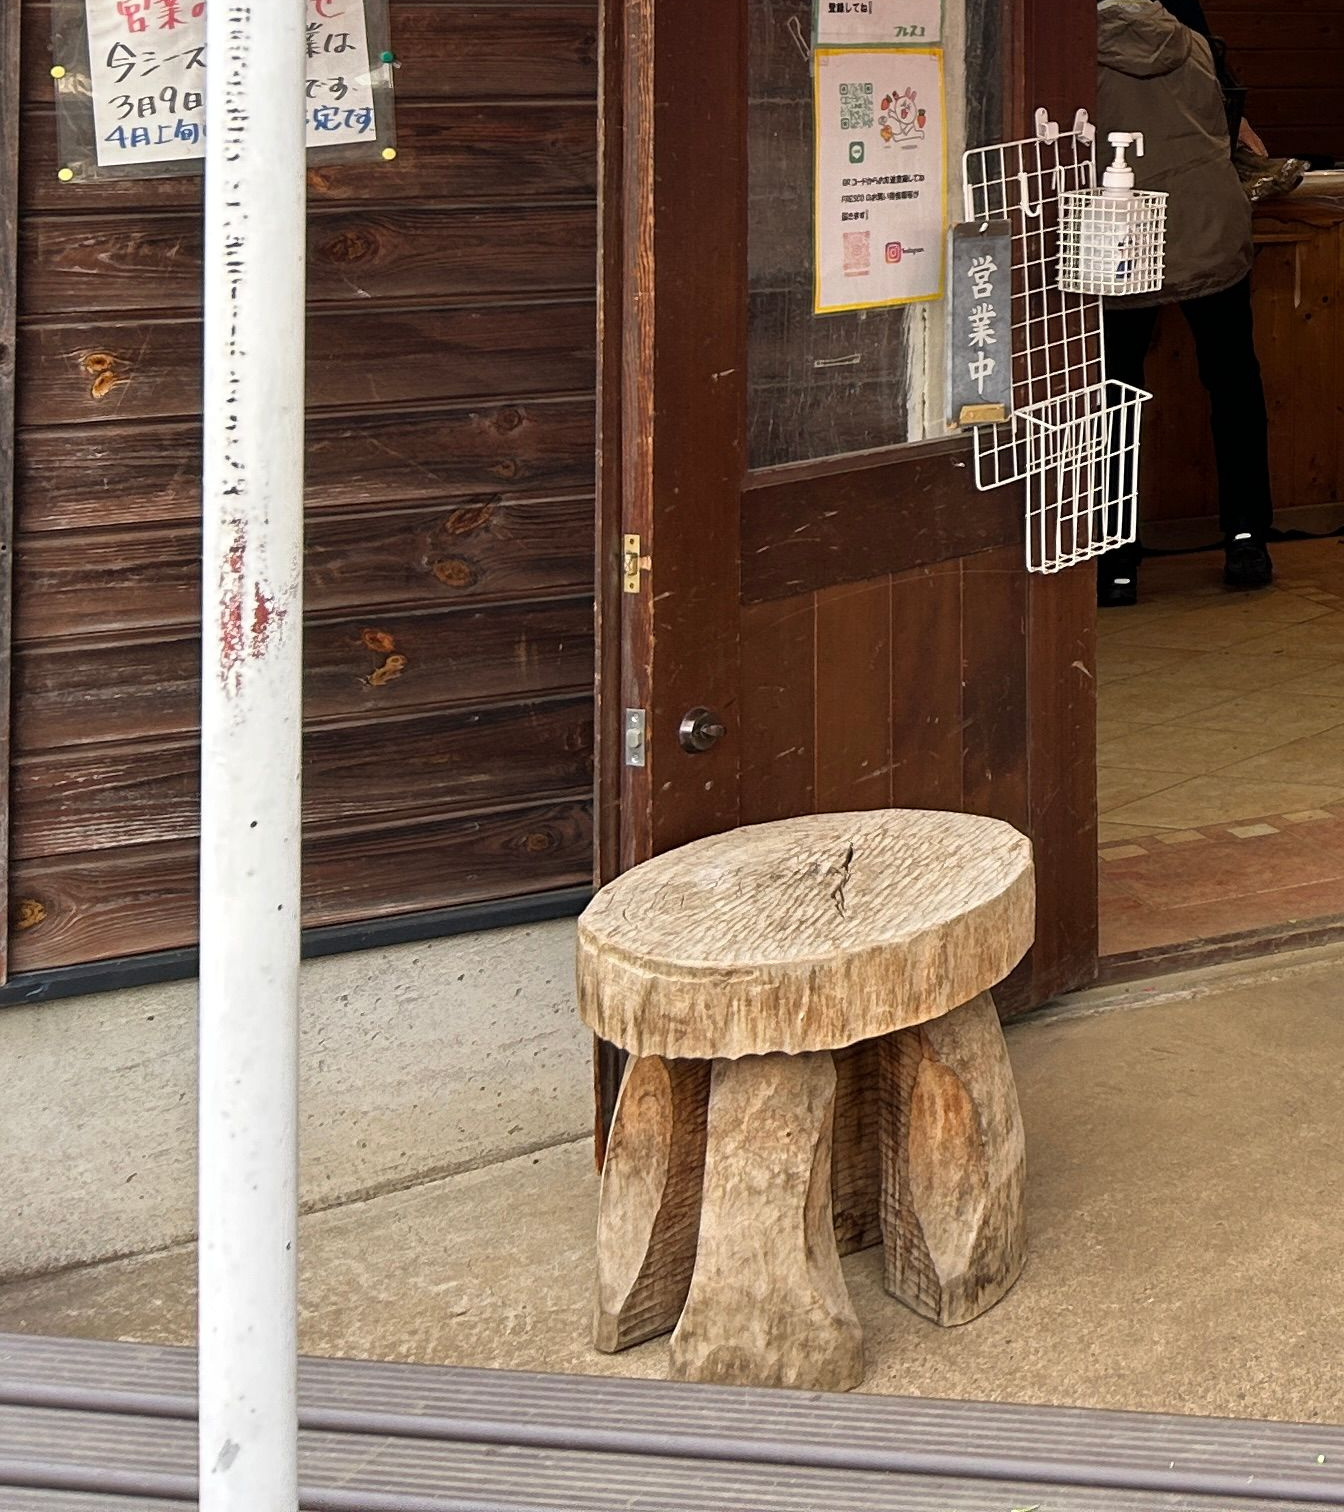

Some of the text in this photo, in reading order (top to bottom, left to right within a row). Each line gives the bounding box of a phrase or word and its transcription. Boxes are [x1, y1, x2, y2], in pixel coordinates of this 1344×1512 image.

[104, 118, 207, 149] 4月上旬
[967, 255, 998, 395] 営業中
